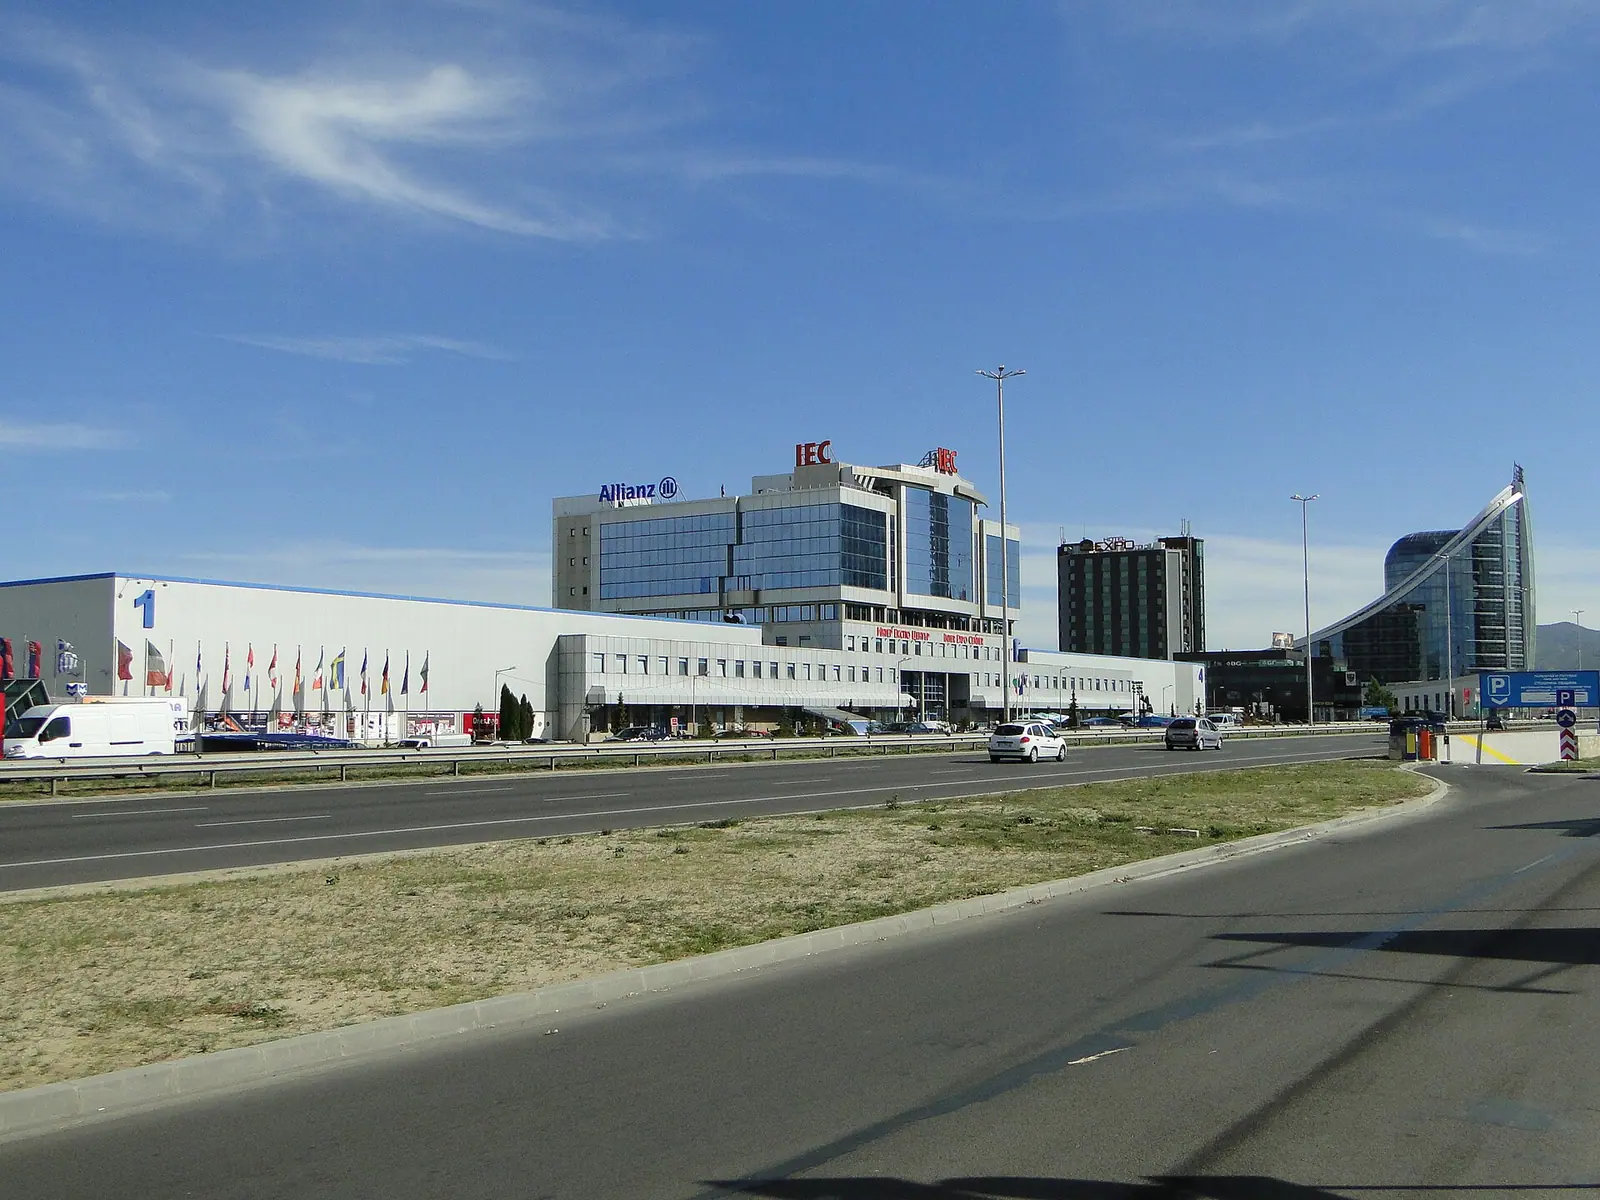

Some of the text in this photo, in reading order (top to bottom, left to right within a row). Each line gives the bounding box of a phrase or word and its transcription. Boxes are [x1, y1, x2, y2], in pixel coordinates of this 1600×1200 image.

[796, 440, 831, 467] IEC
[937, 447, 958, 473] IEC
[599, 483, 655, 502] Allianz
[1095, 540, 1134, 551] EXPO
[134, 589, 155, 628] 1
[1491, 678, 1505, 693] P
[1560, 692, 1570, 704] P
